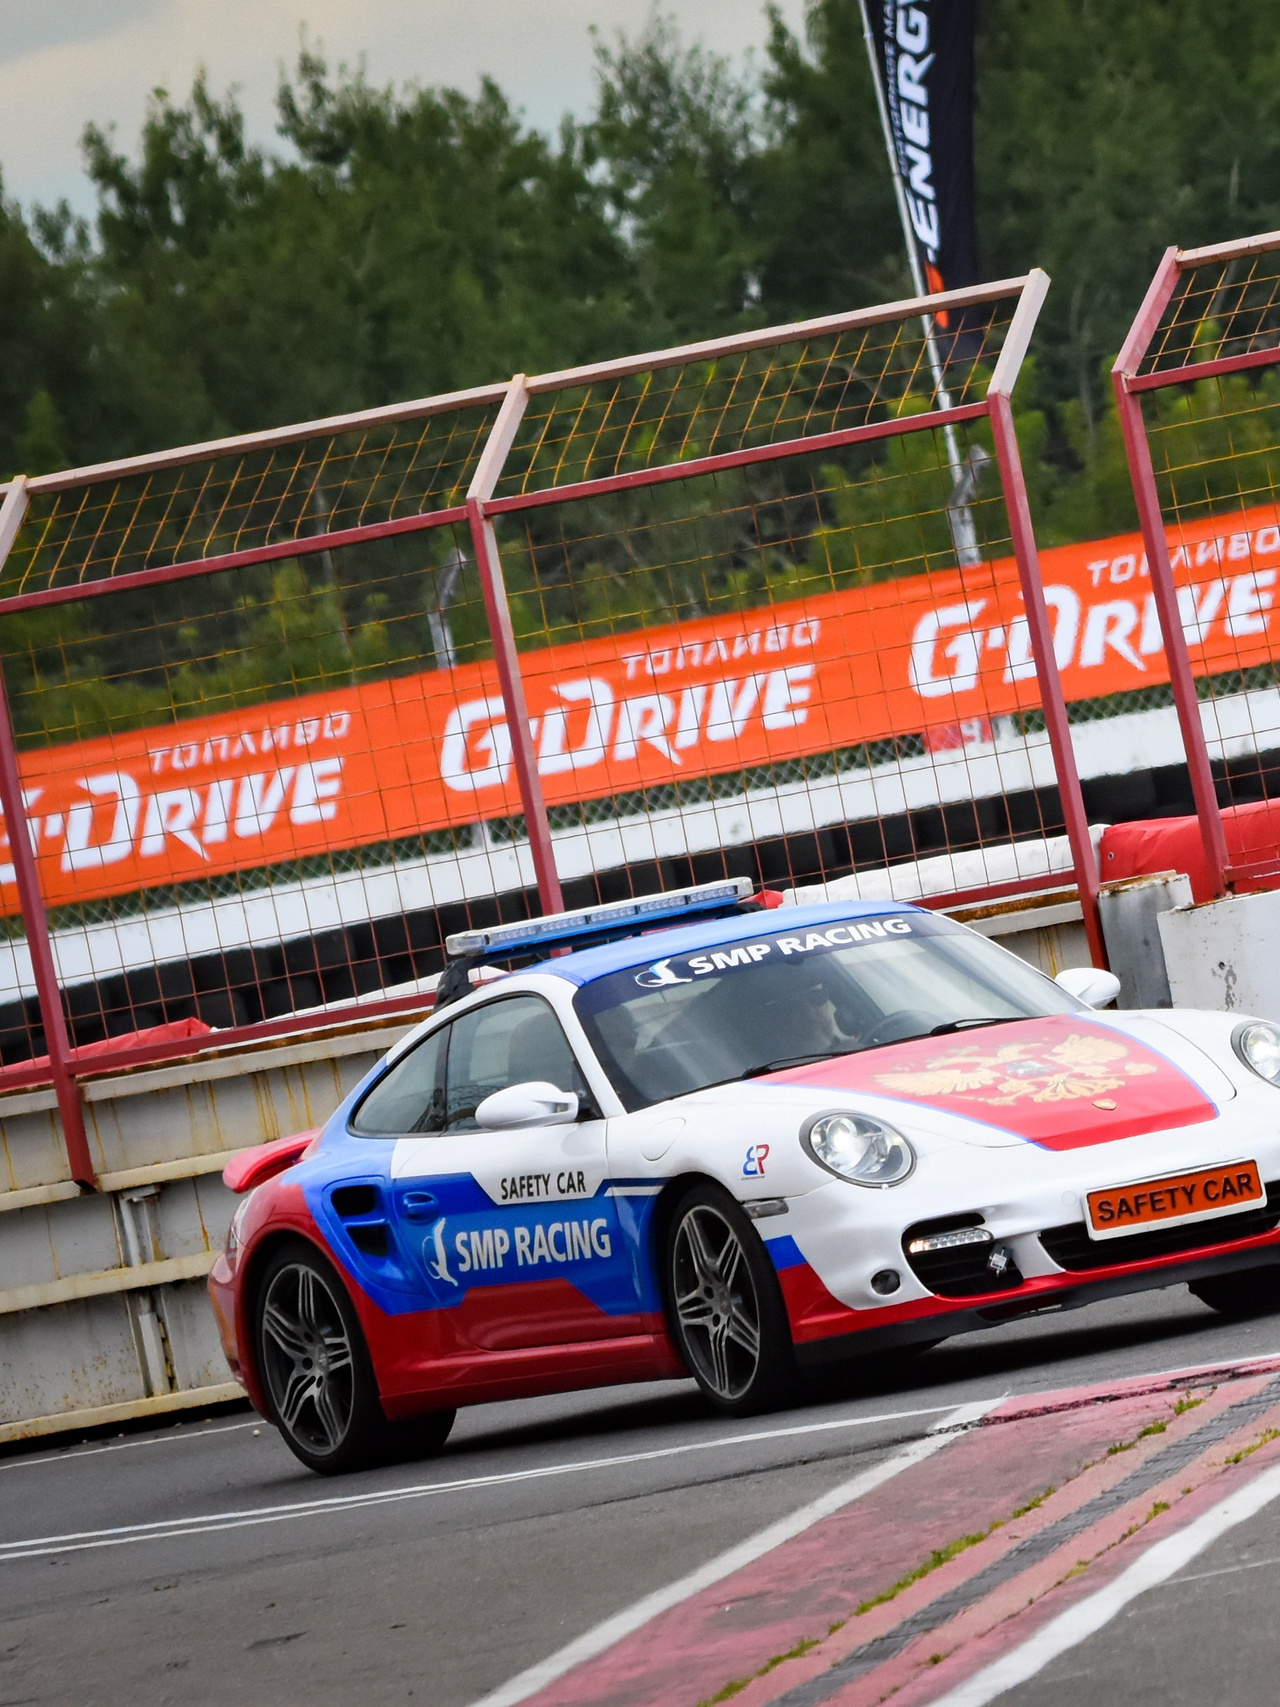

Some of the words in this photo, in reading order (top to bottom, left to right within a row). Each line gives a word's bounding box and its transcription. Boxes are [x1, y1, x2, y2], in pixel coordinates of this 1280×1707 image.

[621, 618, 821, 679] ТОПЛИВО
[148, 710, 351, 774] ТОПЛИВО
[688, 943, 771, 975] SMP
[776, 918, 912, 955] RACING
[500, 1173, 551, 1200] SAFETY
[557, 1171, 586, 1194] CAR
[1097, 1183, 1196, 1222] SAFETY
[1203, 1172, 1253, 1202] CAR
[455, 1226, 510, 1272] SMP
[514, 1218, 612, 1267] RACING
